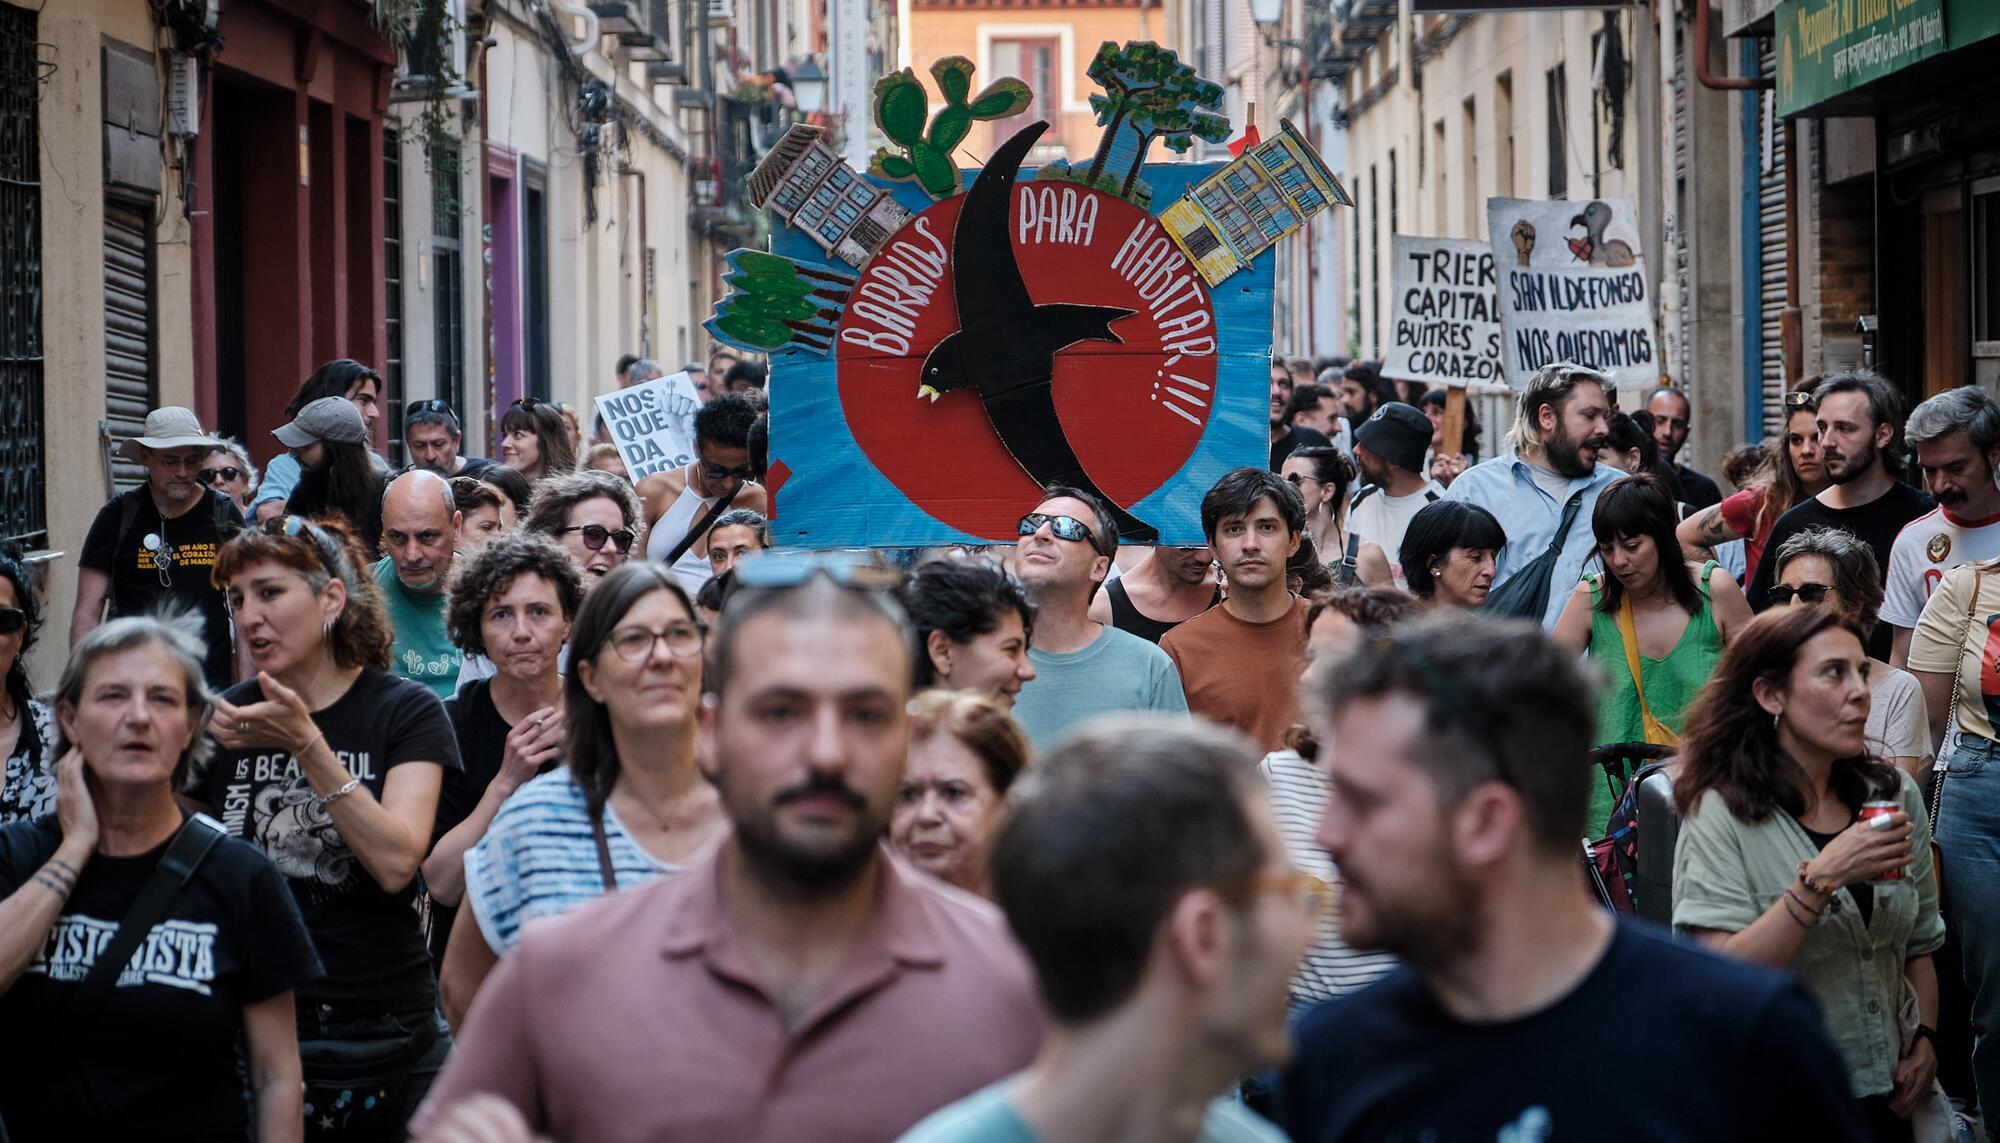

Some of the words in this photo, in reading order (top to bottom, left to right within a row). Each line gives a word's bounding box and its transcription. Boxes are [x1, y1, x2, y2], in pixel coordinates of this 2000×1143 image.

[841, 216, 948, 357] BARRIOS
[1019, 186, 1099, 246] PARA
[1510, 271, 1547, 312] SAN
[1549, 271, 1644, 312] ILDEFONSO
[1396, 316, 1473, 350] BUITRES
[1516, 328, 1553, 371] NOS
[1556, 328, 1651, 369] QUEDAMOS
[603, 388, 655, 421] NOS
[615, 409, 669, 442] QUE
[624, 438, 665, 466] DA
[235, 758, 249, 779] IS
[254, 751, 375, 782] BEAFUL
